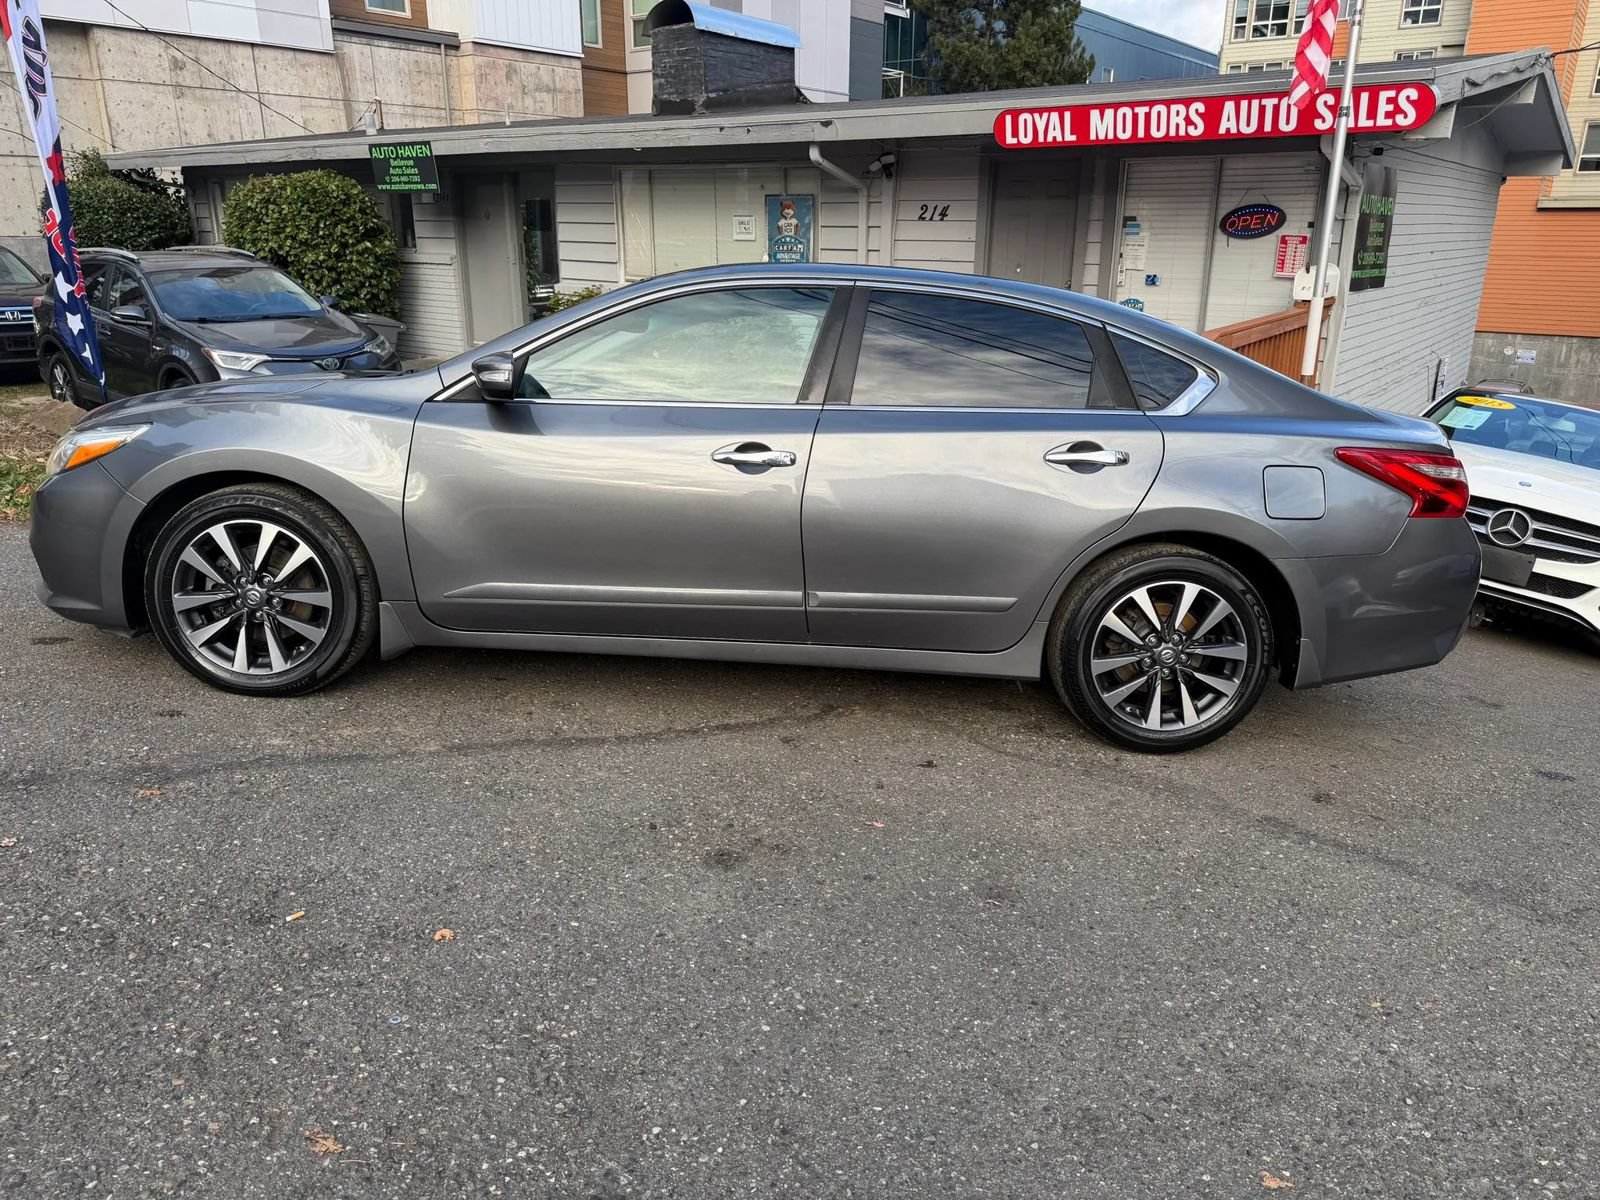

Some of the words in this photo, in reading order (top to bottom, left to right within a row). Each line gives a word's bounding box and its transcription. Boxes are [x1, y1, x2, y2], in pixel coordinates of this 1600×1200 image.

[1005, 111, 1077, 145] LOYAL
[1089, 101, 1206, 141] MOTORS
[1218, 97, 1298, 135] AUTO
[371, 146, 397, 159] AUTO
[397, 144, 431, 158] HAVEN
[917, 203, 951, 221] 214
[1226, 213, 1279, 232] OPEN
